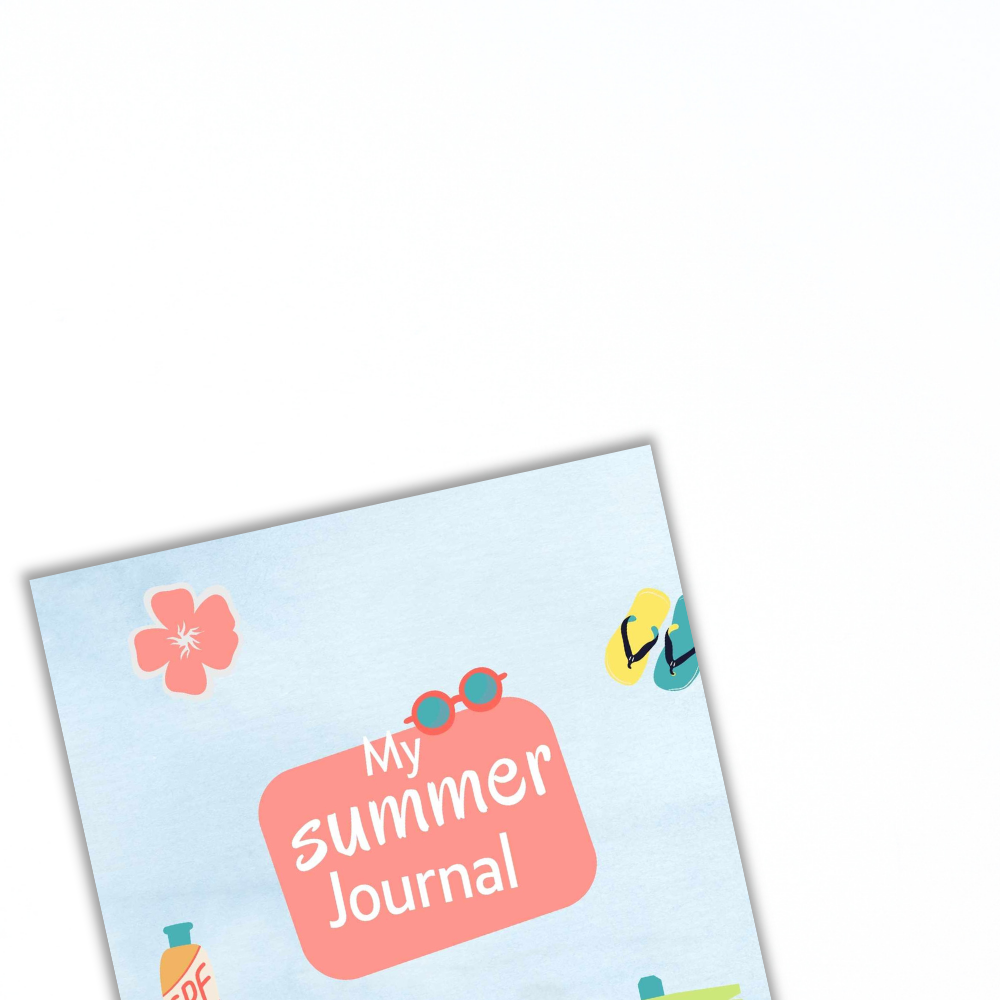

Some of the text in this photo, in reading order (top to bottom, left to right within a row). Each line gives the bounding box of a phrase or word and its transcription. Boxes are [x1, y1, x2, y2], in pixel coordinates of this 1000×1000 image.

[363, 730, 421, 779] My
[291, 744, 552, 872] summer
[329, 832, 519, 928] Journal
